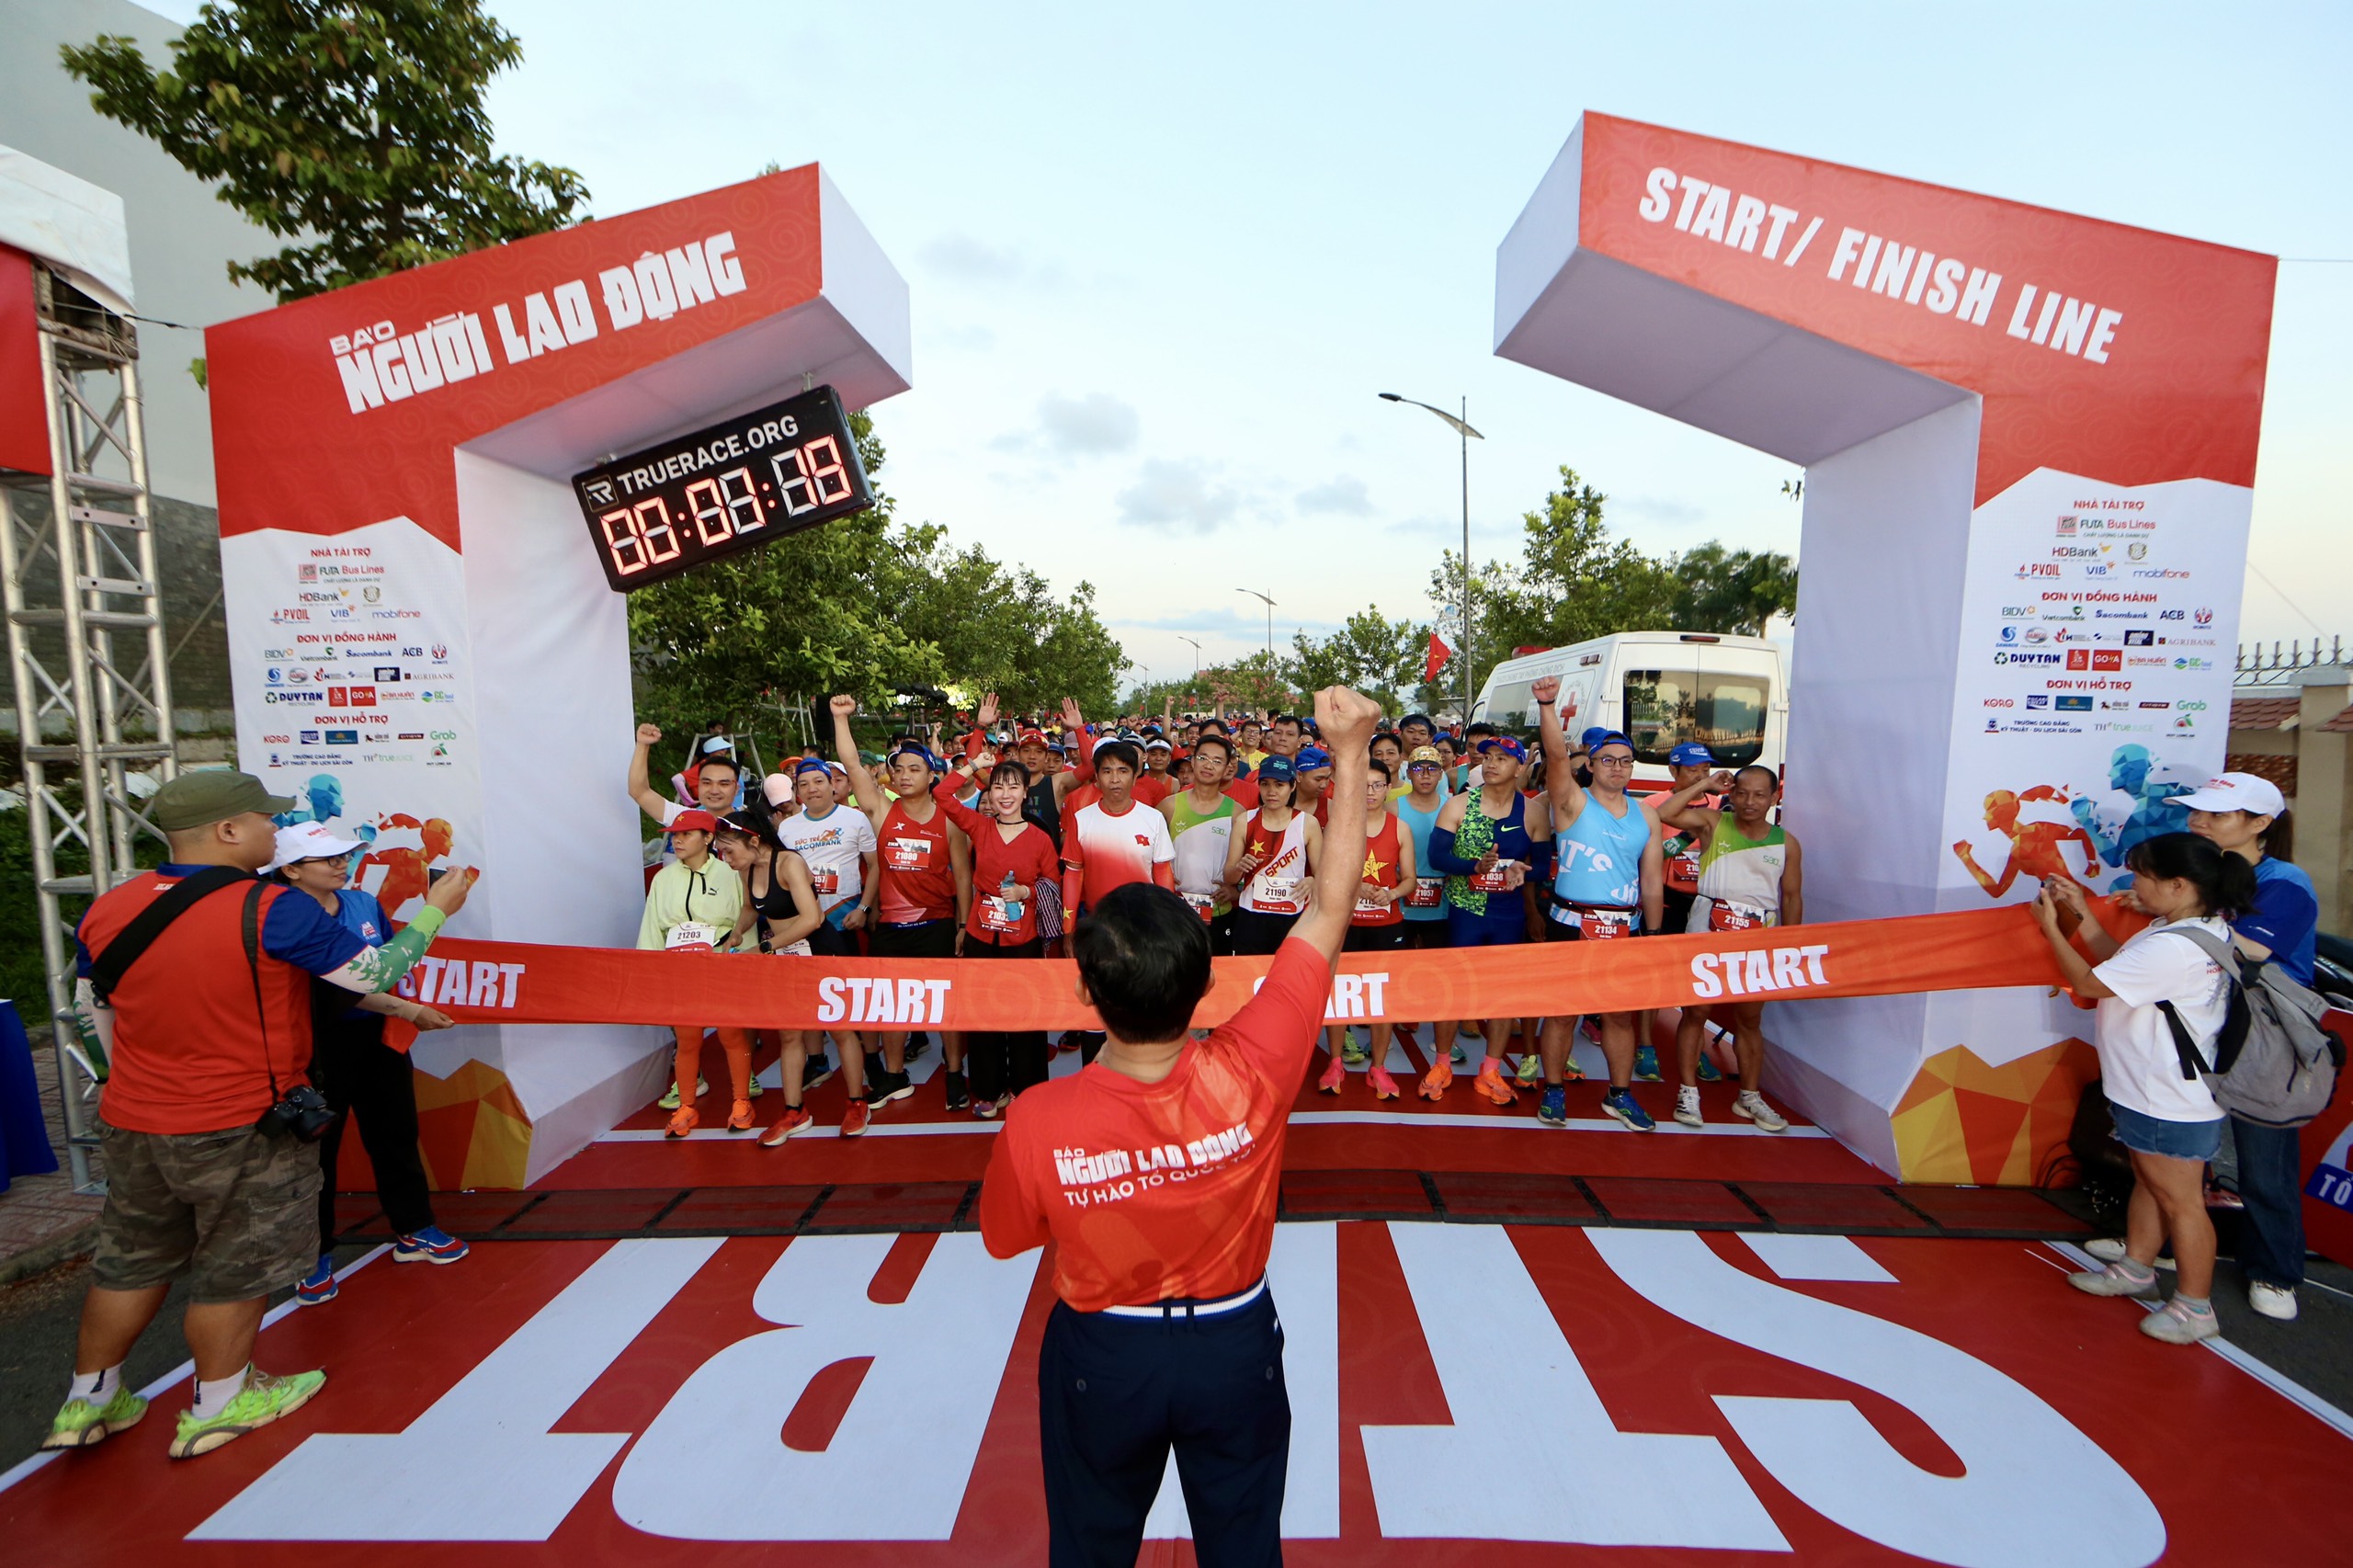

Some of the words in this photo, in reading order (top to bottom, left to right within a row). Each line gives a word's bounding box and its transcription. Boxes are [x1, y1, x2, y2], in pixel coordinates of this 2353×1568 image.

[1639, 167, 1824, 267] START/
[1827, 228, 2003, 326] FINISH
[2006, 284, 2123, 363] LINE
[335, 312, 494, 415] NGƯỜI
[493, 278, 598, 365] LAO
[598, 230, 747, 323] ĐỘNG
[329, 320, 396, 357] BÁO
[616, 415, 800, 495] TRUERACE.ORG
[2074, 497, 2098, 509] NHÀ
[2102, 498, 2120, 510] TÀI
[2123, 500, 2145, 512] TRỢ
[2080, 519, 2104, 529] FUTA
[2107, 519, 2127, 529] Bus
[2129, 519, 2156, 529] Lines
[311, 546, 332, 557] NHÀ
[335, 546, 350, 557] TÀI
[353, 547, 371, 558] TRỢ
[2052, 547, 2098, 557] HDBank
[342, 565, 359, 574] Bus
[361, 564, 384, 574] Lines
[2030, 563, 2061, 576] PVOIL
[2086, 565, 2107, 575] VIB
[2132, 568, 2189, 579] mobifone
[299, 592, 339, 602] HDBank
[2041, 592, 2068, 601] ĐƠN
[2071, 593, 2083, 603] VỊ
[2086, 589, 2120, 602] ĐỒNG
[2122, 590, 2157, 602] HÀNH
[283, 608, 311, 620] PVOIL
[330, 608, 349, 619] VIB
[371, 609, 421, 619] mobifone
[2002, 607, 2027, 617] BIDV
[2095, 609, 2149, 619] Sacombank
[2159, 610, 2185, 620] ACB
[297, 634, 320, 643] ĐƠN
[322, 634, 332, 644] VỊ
[335, 631, 365, 642] ĐỒNG
[368, 631, 397, 642] HÀNH
[2168, 638, 2216, 646] AGRIBANK
[265, 649, 285, 659] BIDV
[346, 649, 392, 658] Sacombank
[402, 647, 423, 657] ACB
[2047, 680, 2073, 689] ĐƠN
[2075, 680, 2087, 691] VỊ
[2090, 676, 2107, 690] HỖ
[2109, 681, 2132, 692] TRỢ
[1984, 699, 2014, 708] KORO
[2177, 699, 2207, 710] Grab
[314, 716, 337, 724] ĐƠN
[339, 716, 350, 725] VỊ
[369, 715, 389, 725] TRỢ
[264, 735, 290, 744] KORO
[430, 730, 457, 740] Grab
[794, 838, 842, 851] SACOMBANK
[894, 850, 918, 861] 21080
[1264, 846, 1299, 878] SPORT
[1686, 863, 1699, 872] 210
[814, 875, 826, 883] 157
[1265, 887, 1287, 898] 21190
[1415, 889, 1434, 897] 21057
[1723, 915, 1750, 928] 21155
[677, 930, 701, 940] 21203
[1594, 925, 1618, 935] 21134
[1690, 944, 1829, 999] START
[817, 976, 951, 1024] START
[1053, 1145, 1085, 1158] BÁO
[1054, 1149, 1132, 1186] NGƯỜI
[1134, 1144, 1186, 1172] LAO
[1186, 1123, 1254, 1166] ĐỘNG
[1063, 1187, 1089, 1209] TỰ
[1092, 1180, 1135, 1204] HÀO
